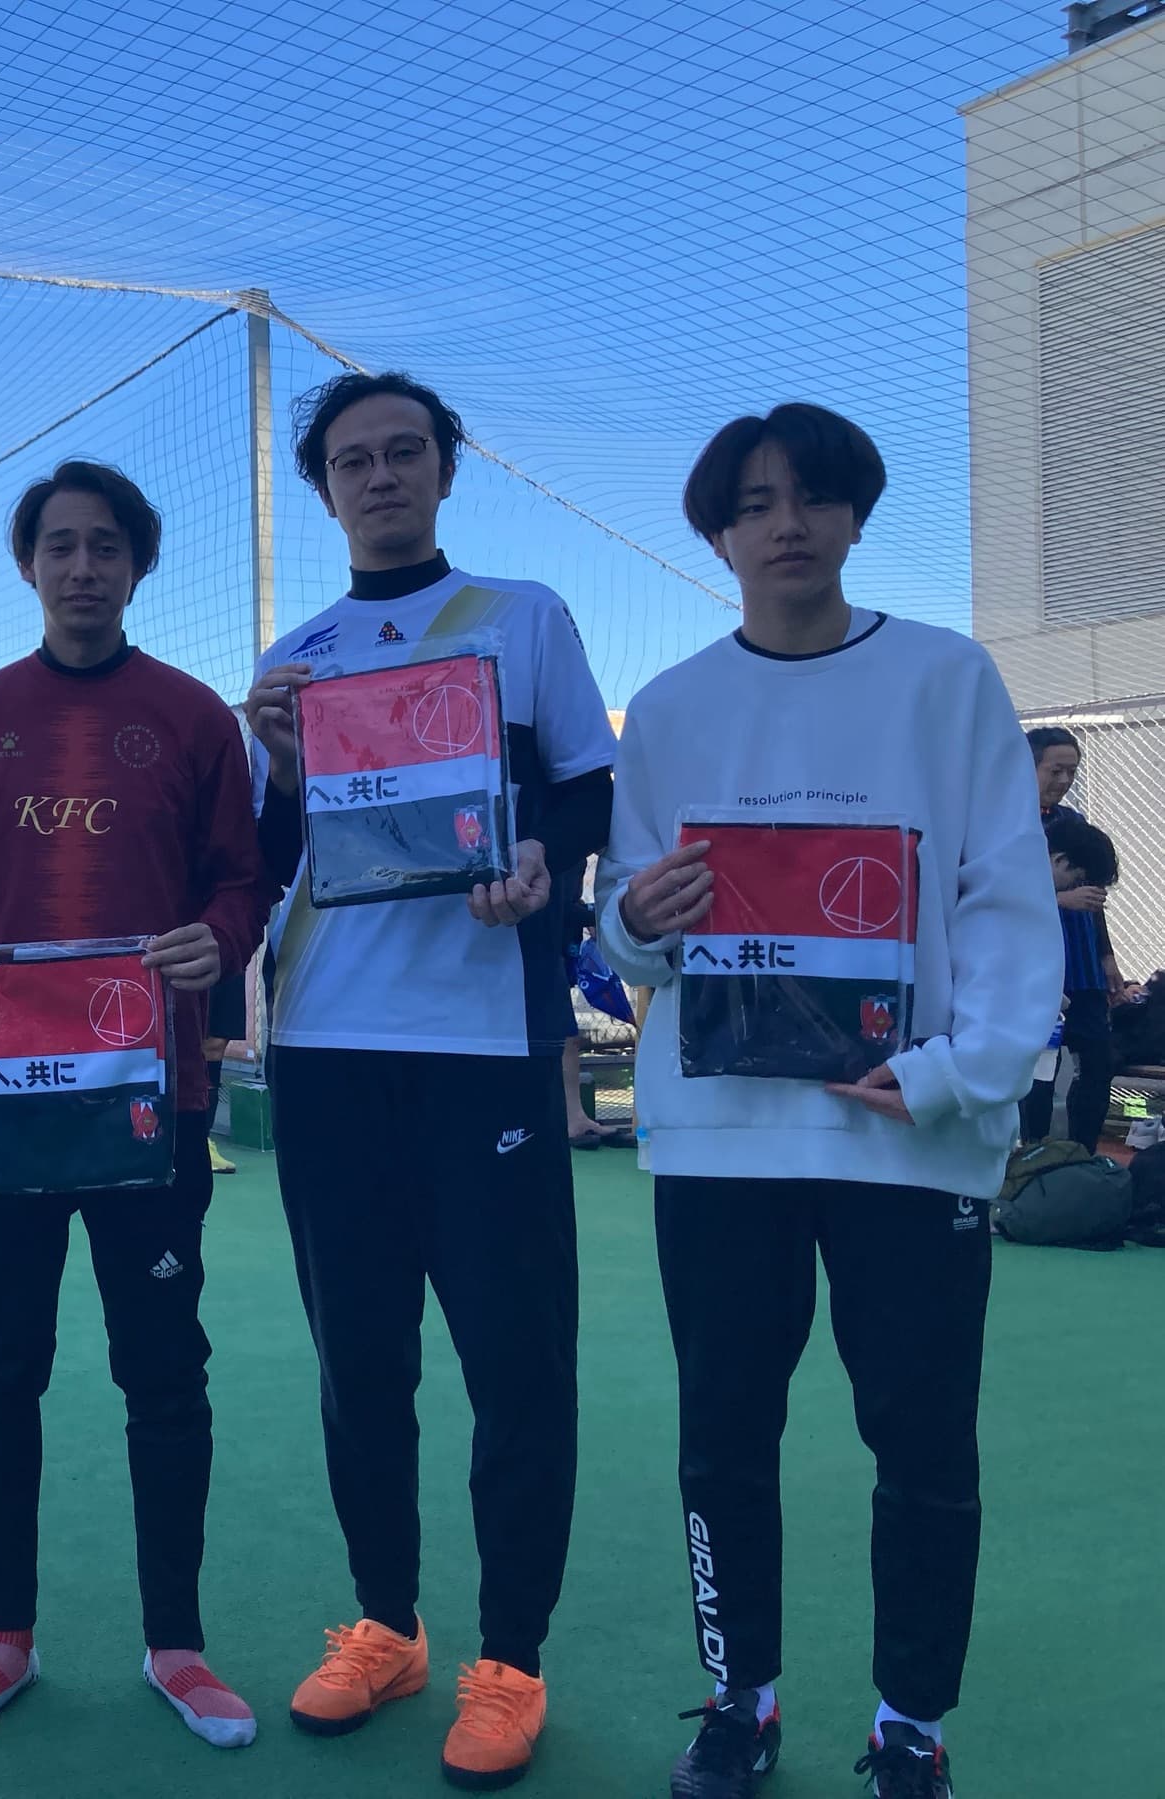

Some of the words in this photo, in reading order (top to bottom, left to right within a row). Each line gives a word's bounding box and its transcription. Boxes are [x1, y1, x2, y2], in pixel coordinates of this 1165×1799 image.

[738, 790, 801, 805] resolution
[806, 788, 868, 805] principle
[14, 795, 118, 835] KFC
[681, 939, 796, 970] へ、共に
[501, 1128, 526, 1145] NIKE
